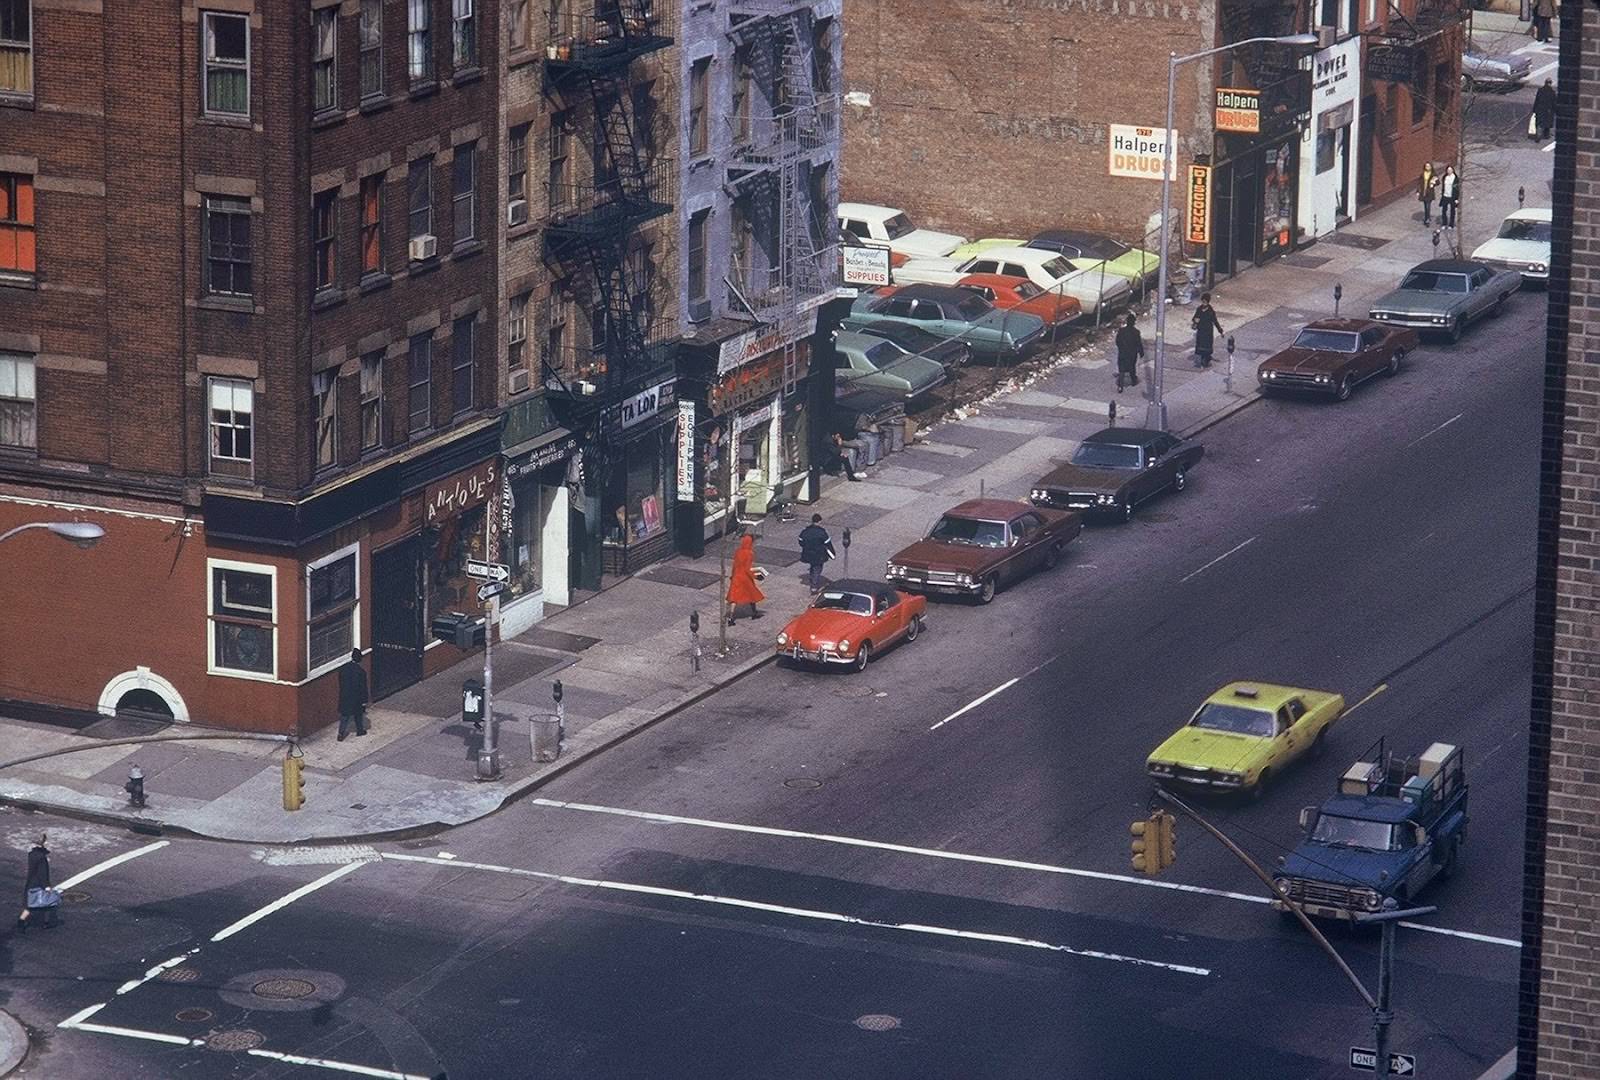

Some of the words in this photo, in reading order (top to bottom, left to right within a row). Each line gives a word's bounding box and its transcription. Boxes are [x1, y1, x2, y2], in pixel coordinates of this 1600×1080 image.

[1217, 92, 1258, 109] Halpern
[1217, 110, 1258, 128] DRUGS
[1192, 167, 1207, 240] DISCOUNTS
[847, 270, 886, 282] SUPPLIES
[622, 393, 657, 422] TALOR
[687, 414, 695, 489] EQUIPMENT
[470, 565, 483, 574] ONE
[1356, 1054, 1374, 1066] ONE
[1392, 1060, 1405, 1070] AY
